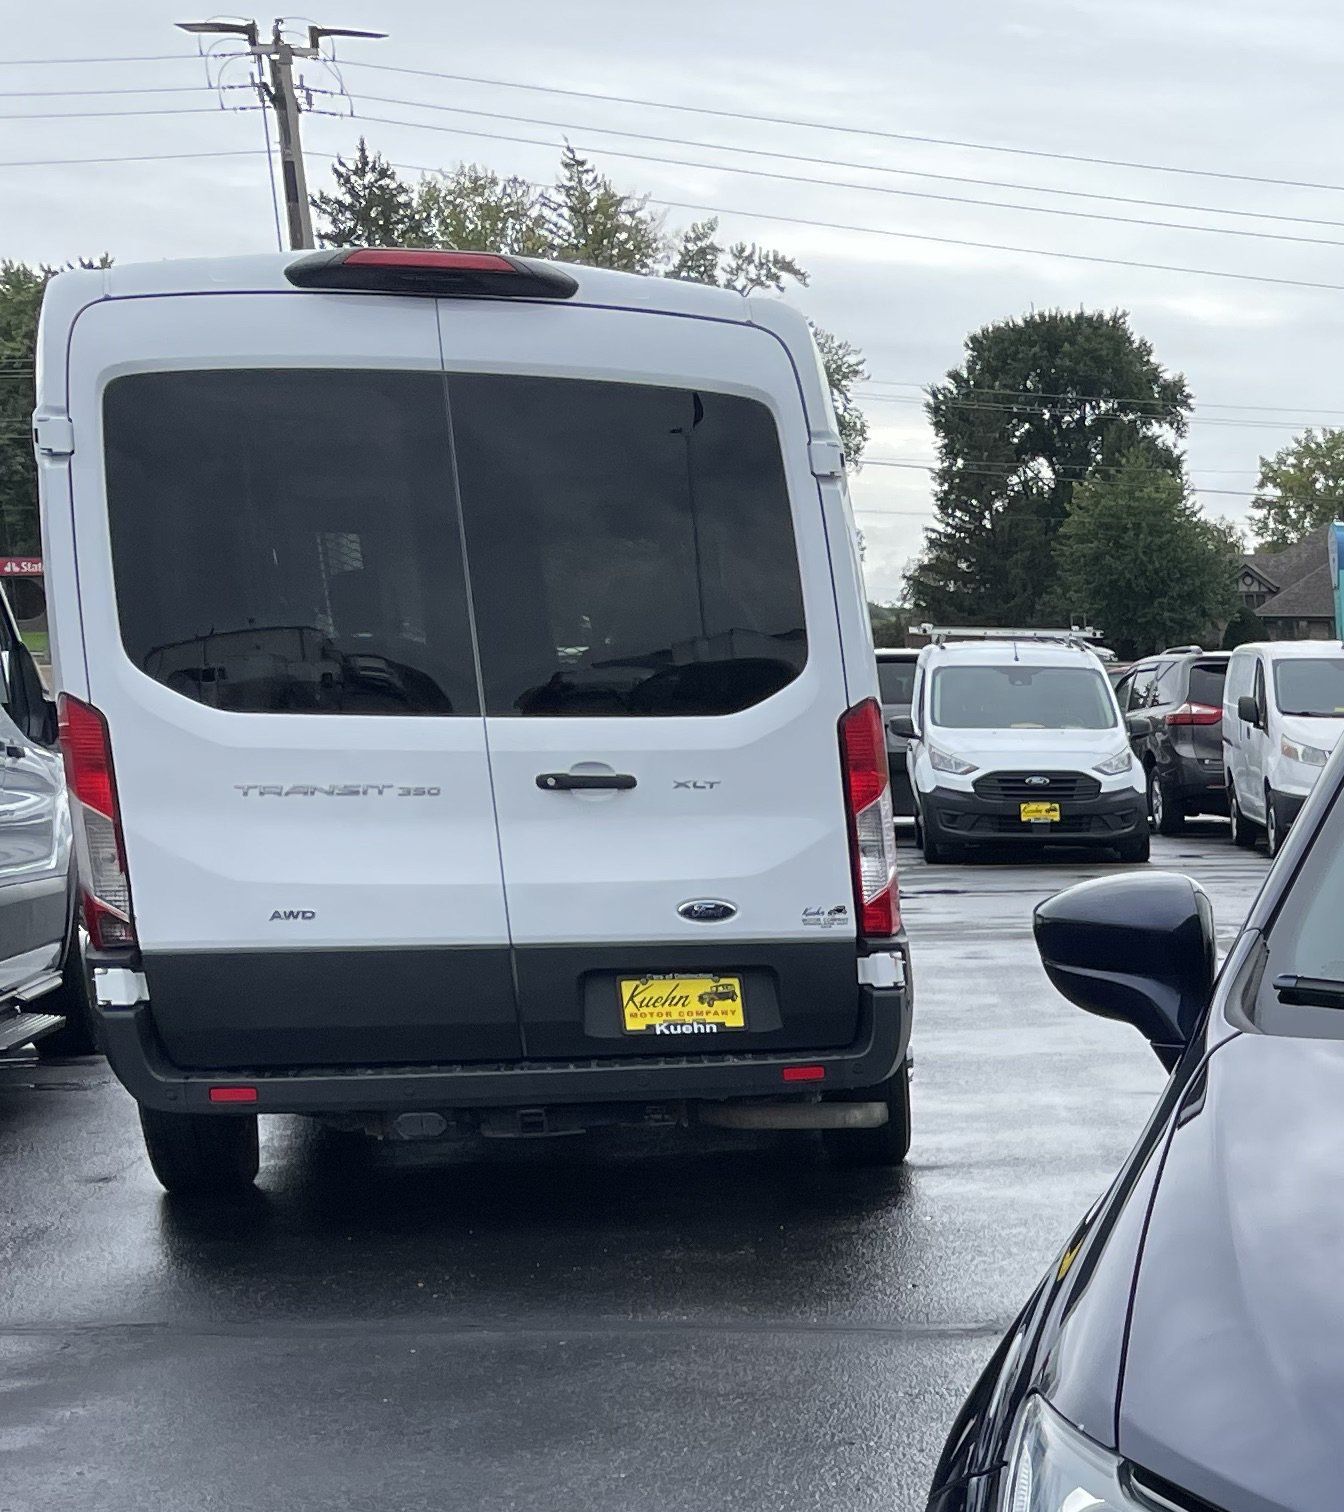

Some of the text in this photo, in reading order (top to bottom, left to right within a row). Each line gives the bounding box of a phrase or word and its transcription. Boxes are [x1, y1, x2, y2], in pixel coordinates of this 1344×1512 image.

[20, 561, 42, 573] Stat
[233, 784, 441, 797] TRANSIT 350
[672, 780, 721, 789] XLT
[269, 910, 316, 921] AWD
[625, 983, 690, 1011] Kuehn
[629, 1009, 737, 1019] MOTOR COMPANY
[656, 1022, 718, 1035] Kuehn
